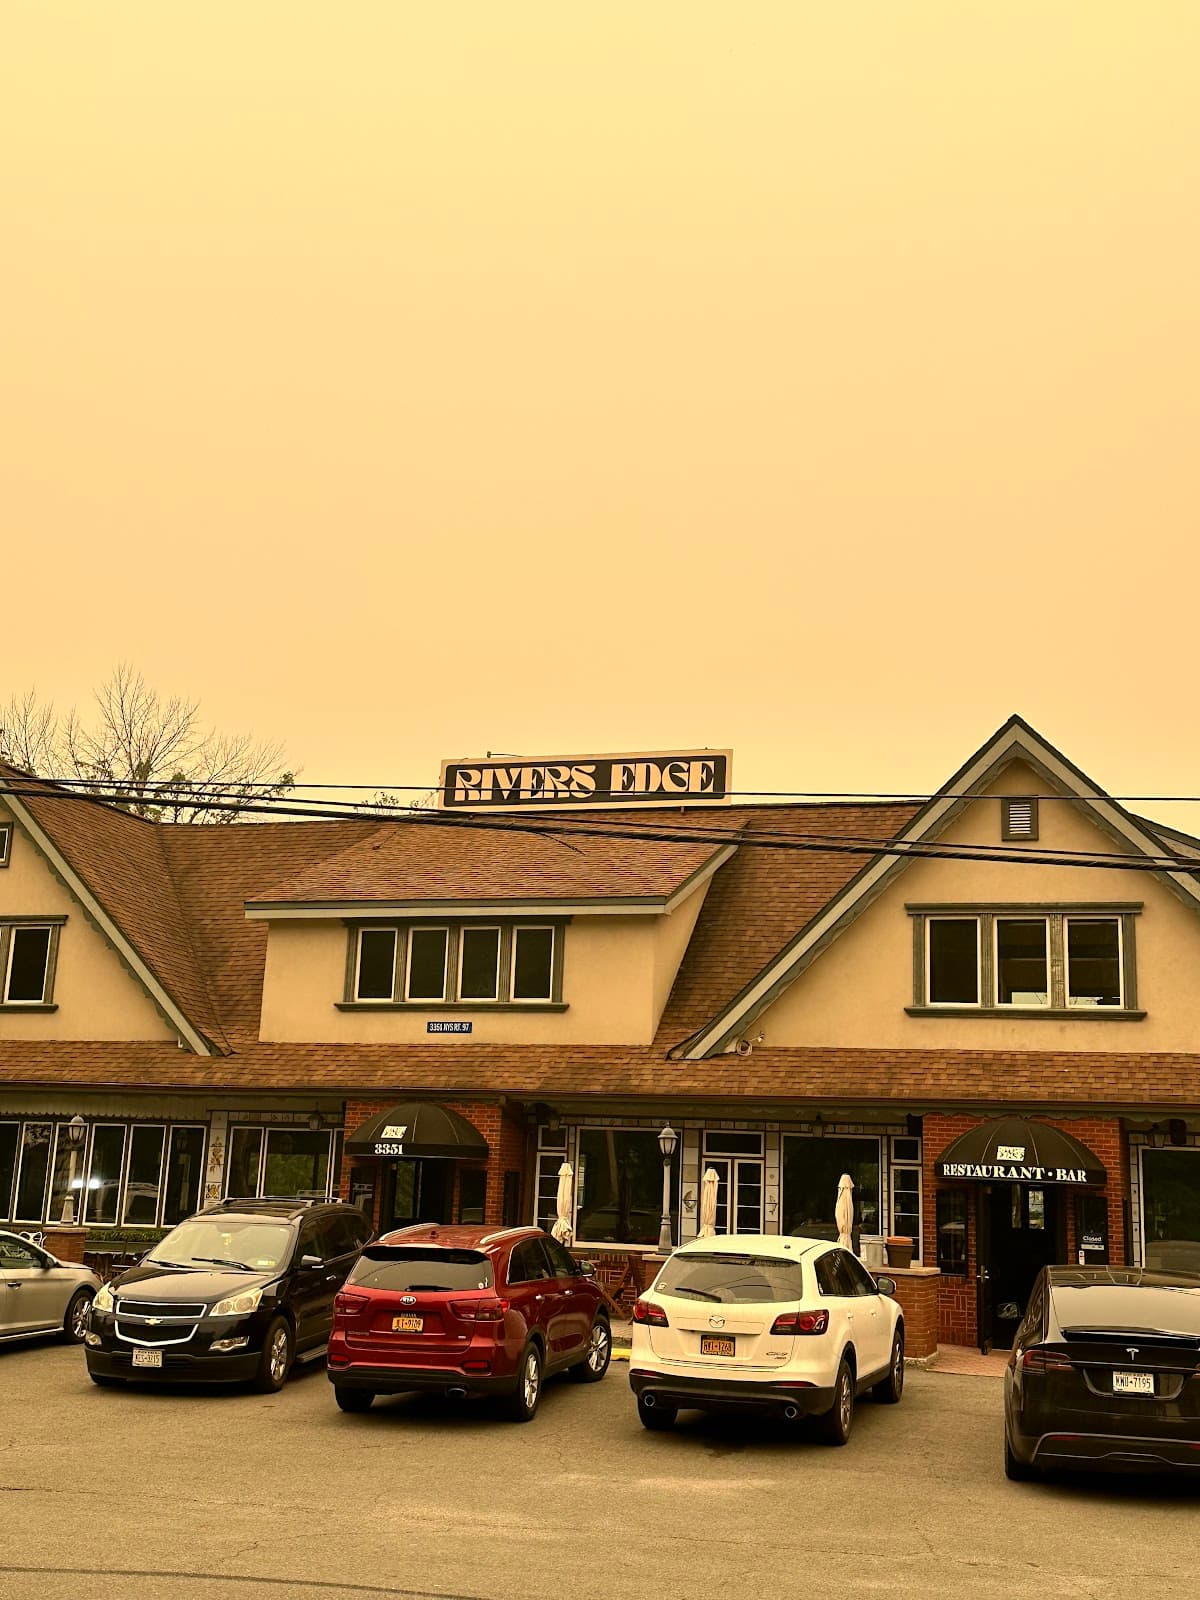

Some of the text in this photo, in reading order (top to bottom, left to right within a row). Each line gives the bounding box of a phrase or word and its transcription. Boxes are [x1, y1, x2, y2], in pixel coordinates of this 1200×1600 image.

[454, 760, 715, 801] RIVERS EDGE
[429, 1023, 443, 1031] 3351
[374, 1143, 404, 1155] 3351
[943, 1164, 1087, 1182] RESTAURANT BAR
